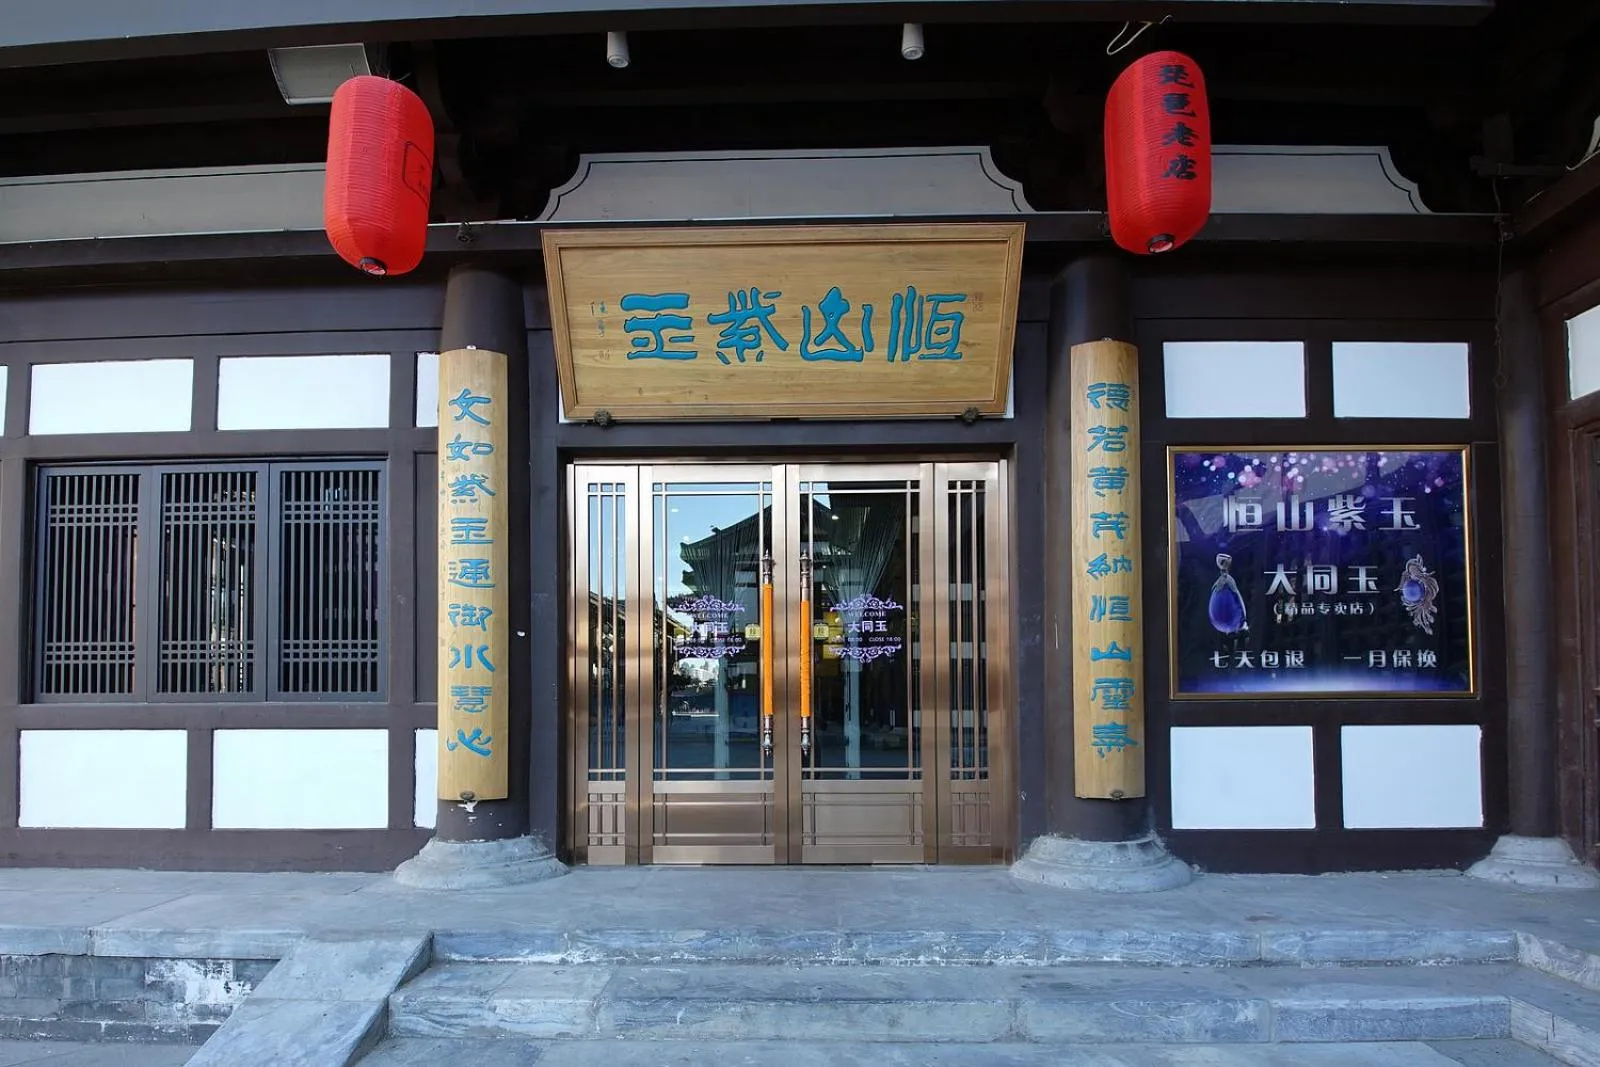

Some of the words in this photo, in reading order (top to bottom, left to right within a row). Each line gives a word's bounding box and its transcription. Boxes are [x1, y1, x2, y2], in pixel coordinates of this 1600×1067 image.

[1223, 494, 1421, 533] 恒山紫玉
[1264, 564, 1381, 595] 大同玉
[848, 620, 887, 633] 大同玉
[1209, 650, 1305, 669] 七天包退
[1344, 650, 1438, 669] 一月保换
